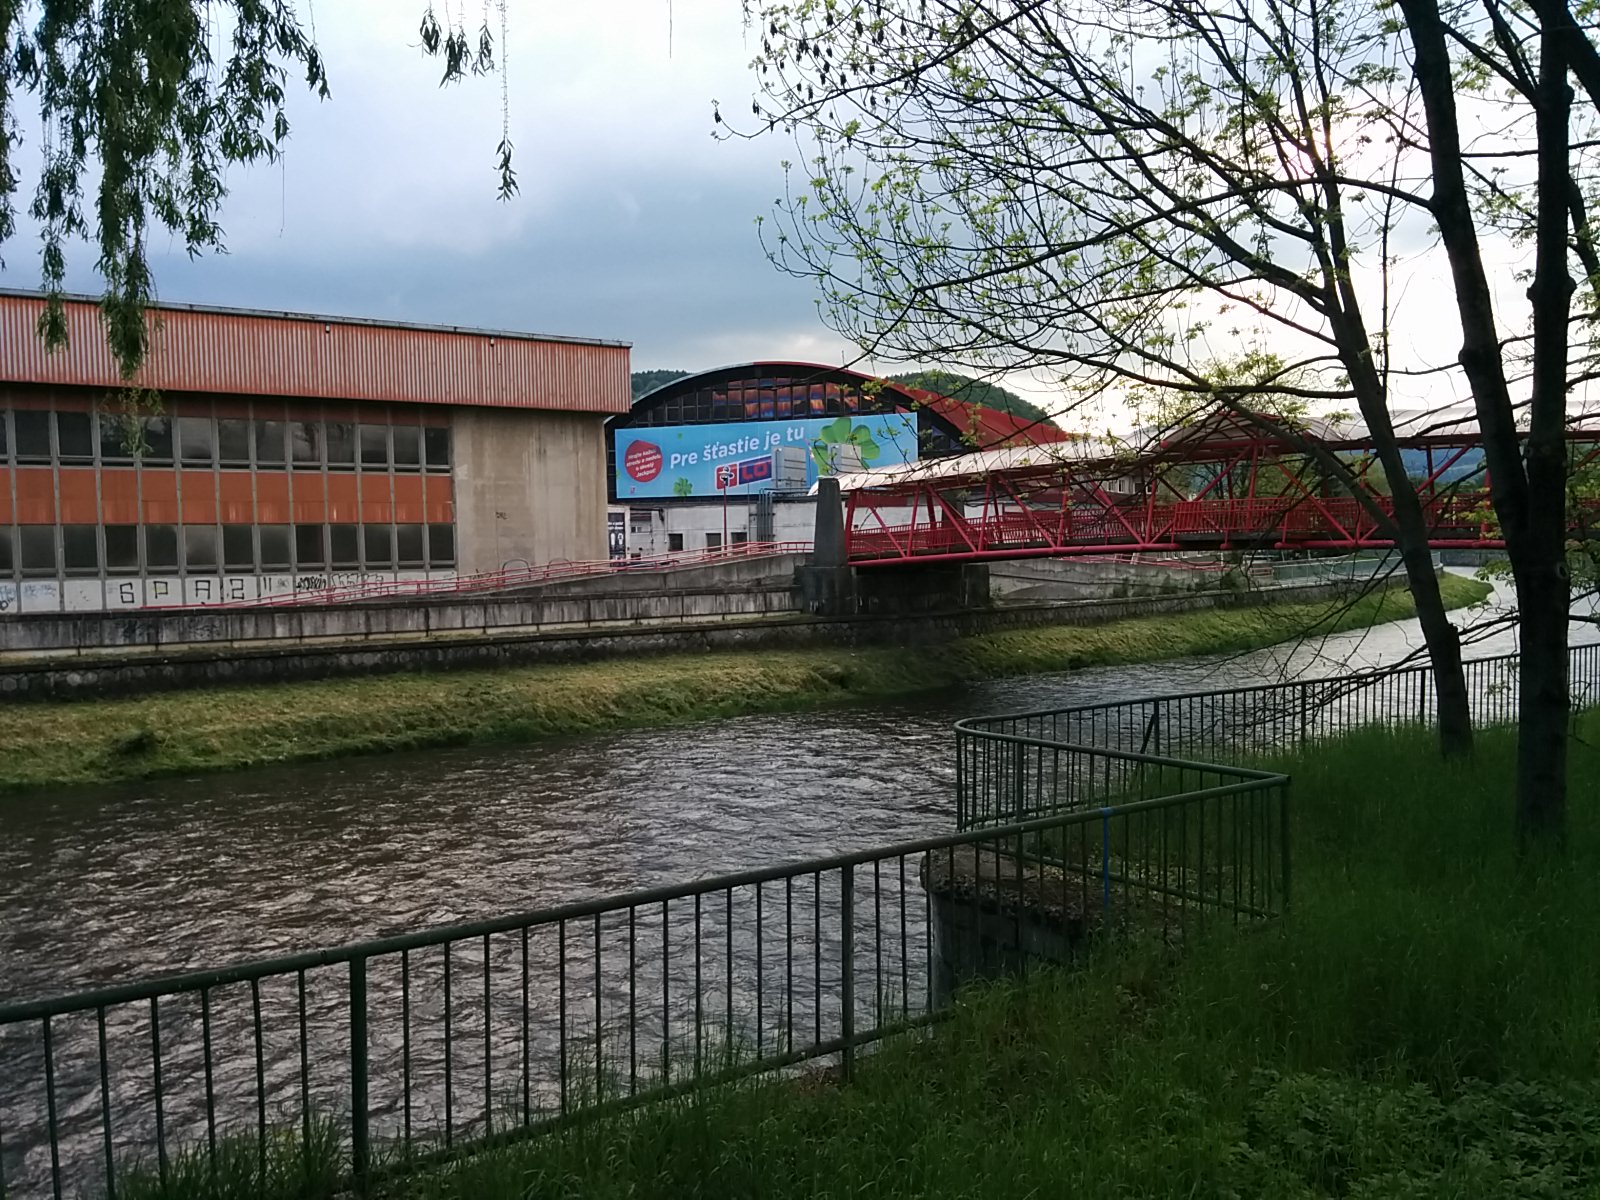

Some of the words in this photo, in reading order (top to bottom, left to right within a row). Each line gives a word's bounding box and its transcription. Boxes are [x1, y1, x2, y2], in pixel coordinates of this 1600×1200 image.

[670, 452, 698, 469] Pre
[702, 436, 760, 461] šťastie
[763, 431, 781, 451] je
[786, 427, 804, 442] tu
